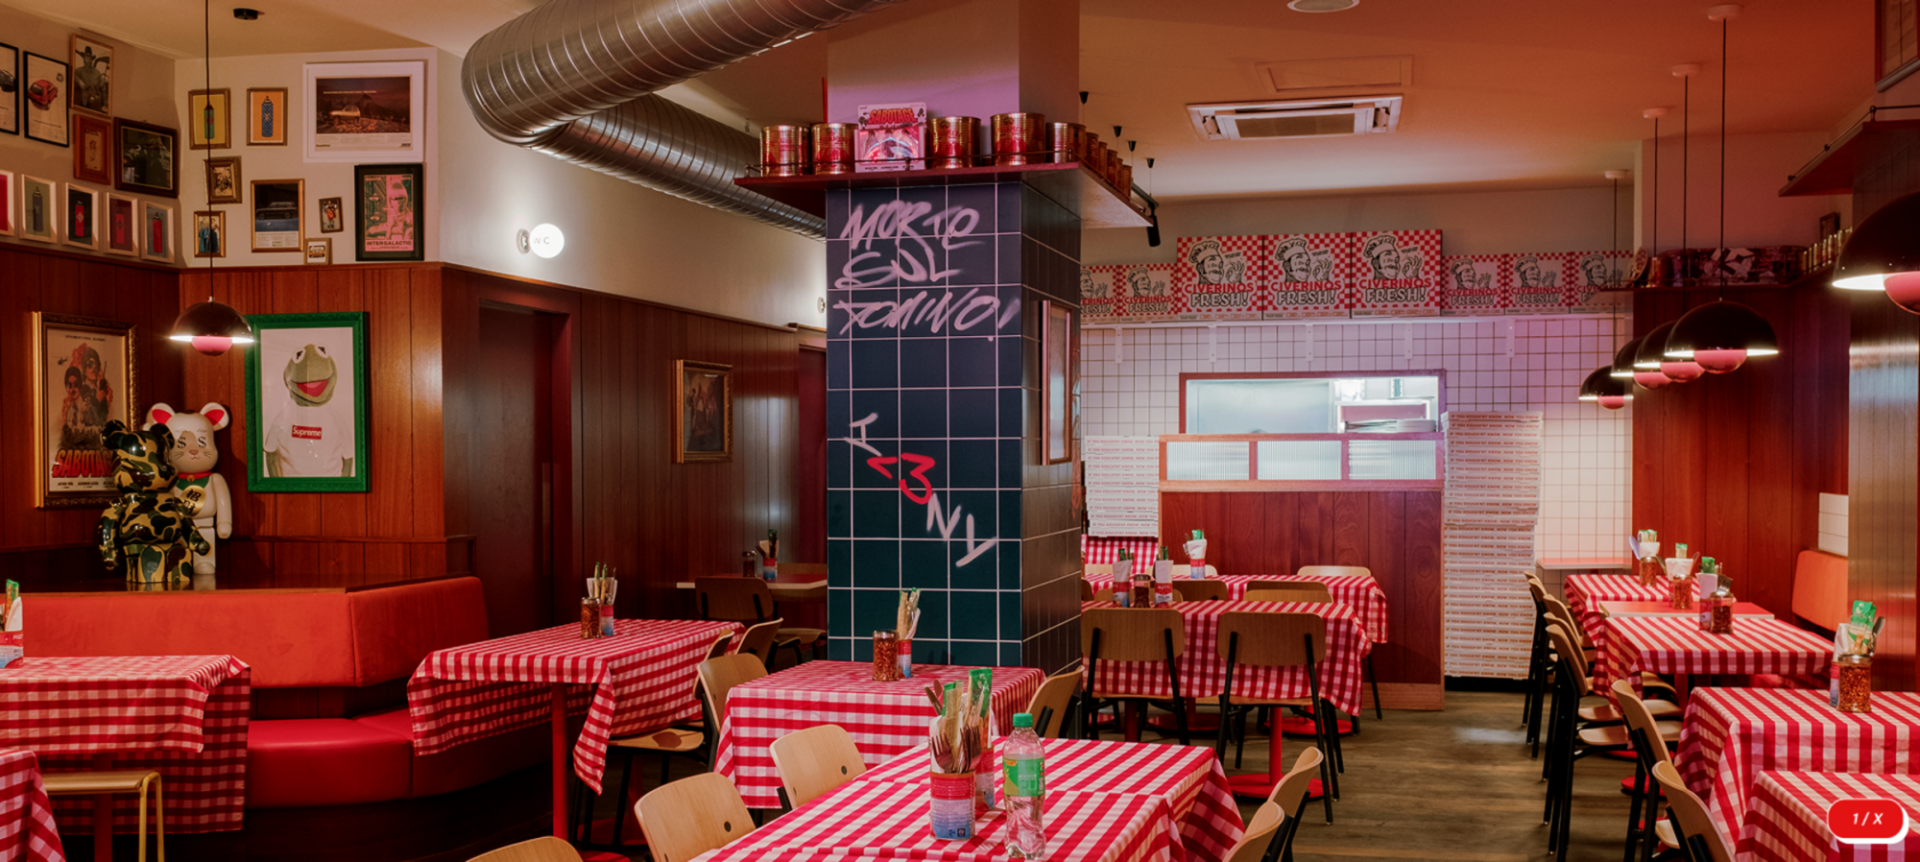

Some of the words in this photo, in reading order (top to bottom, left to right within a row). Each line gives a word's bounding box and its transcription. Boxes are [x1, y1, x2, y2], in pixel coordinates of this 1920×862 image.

[868, 108, 918, 124] SABOTAGE
[533, 236, 550, 245] WC
[1184, 282, 1254, 293] CIVERINOS
[1271, 280, 1342, 292] CIVERINOS
[1358, 278, 1432, 289] CIVERINOS
[1365, 286, 1426, 303] FRESH!
[1447, 287, 1499, 296] CIVERINOS
[1510, 286, 1564, 295] CIVERINOS
[1124, 296, 1172, 304] CIVERINOS
[1191, 291, 1249, 308] FRESH!
[1277, 289, 1337, 306] FRESH!
[1451, 295, 1495, 306] FRESH!
[1515, 293, 1560, 304] FRESH!
[1128, 303, 1168, 313] FRESH!
[292, 426, 322, 438] Supreme
[177, 437, 187, 449] $
[197, 436, 208, 449] $
[52, 448, 113, 478] SABOTAG
[926, 493, 996, 567] NY
